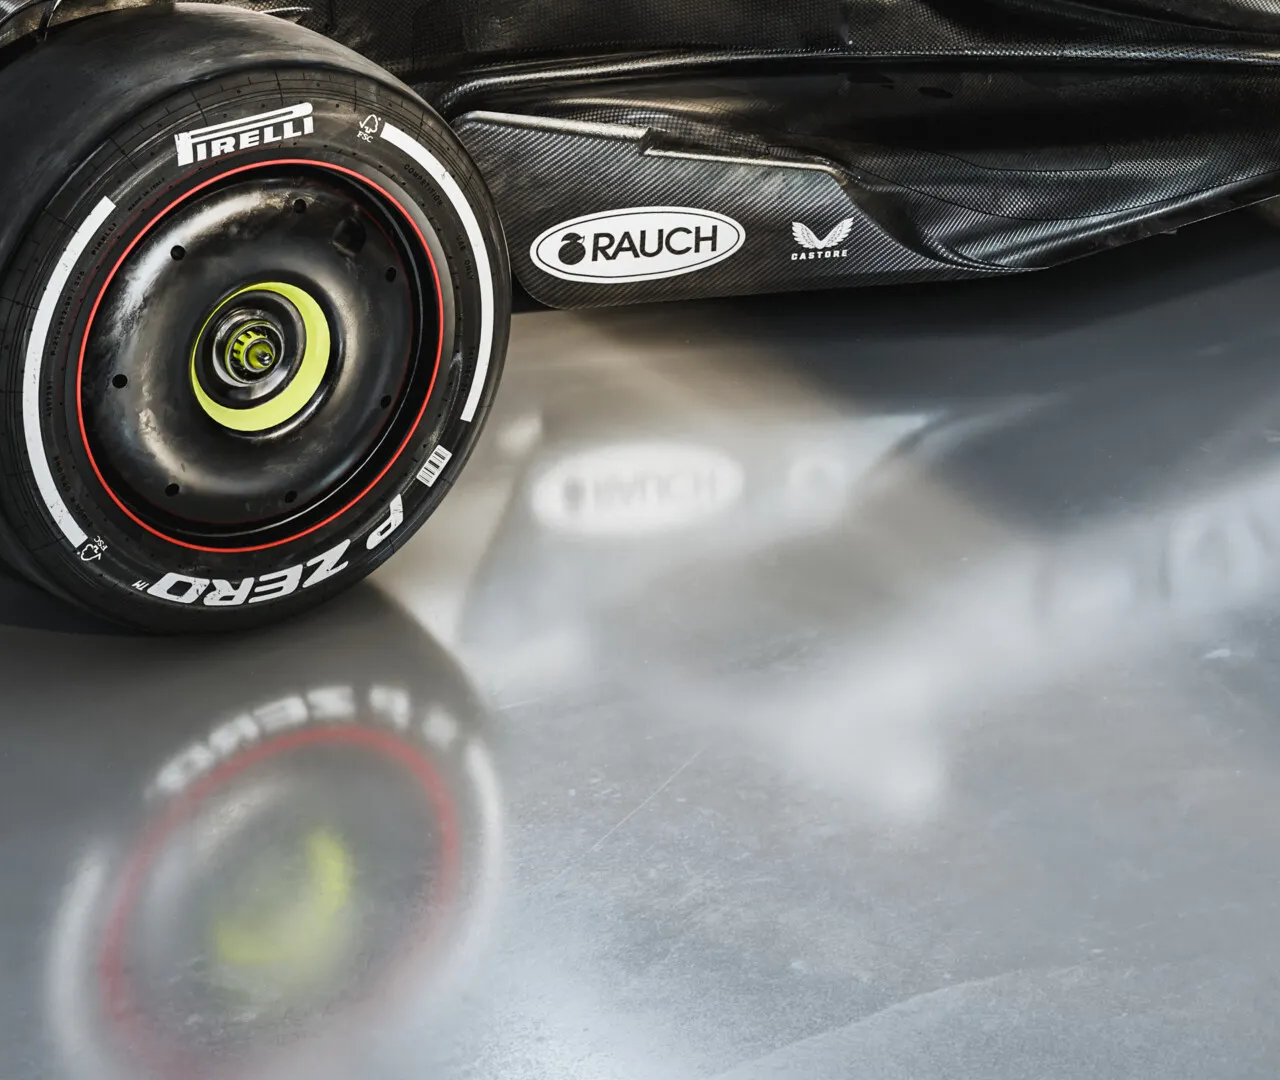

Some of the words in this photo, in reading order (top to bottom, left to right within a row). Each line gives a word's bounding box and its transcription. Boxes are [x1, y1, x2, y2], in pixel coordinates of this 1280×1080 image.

[174, 102, 314, 167] PIRELLI
[403, 164, 443, 207] COMPETITION
[591, 224, 718, 261] RAUCH
[791, 249, 849, 261] CASTORE
[366, 493, 404, 550] P
[147, 539, 352, 607] ZERO
